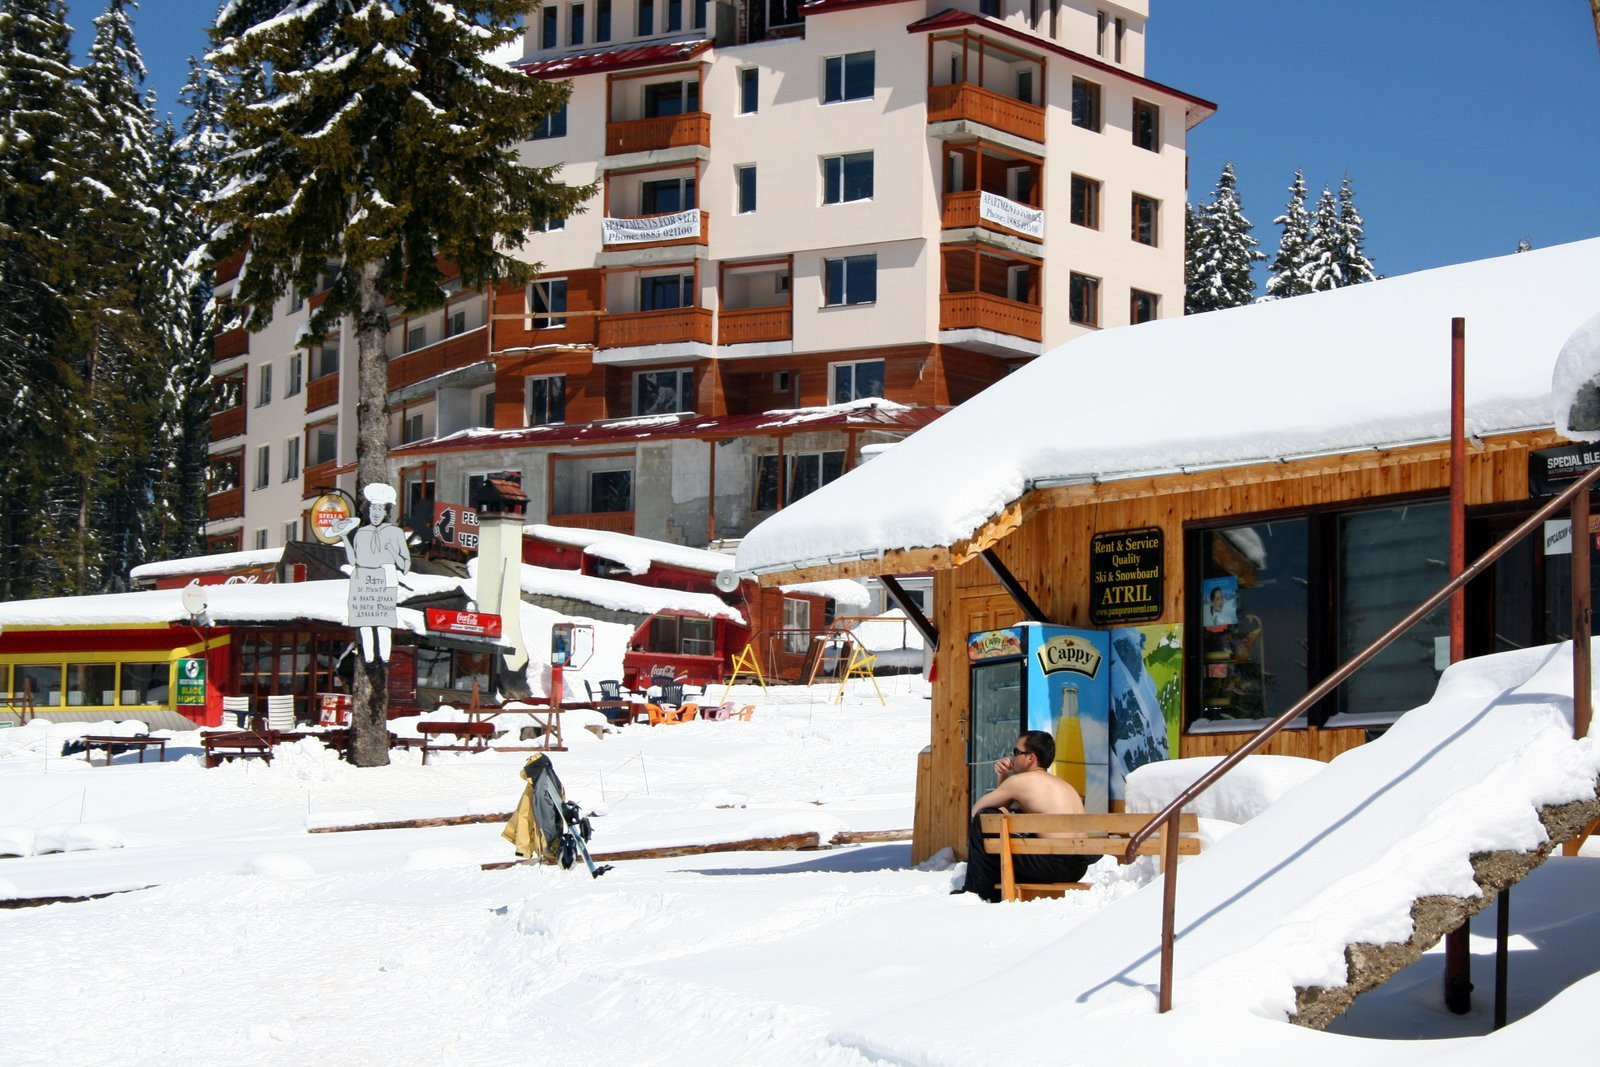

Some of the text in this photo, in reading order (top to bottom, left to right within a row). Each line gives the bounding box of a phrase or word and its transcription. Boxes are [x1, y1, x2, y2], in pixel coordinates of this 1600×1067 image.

[605, 218, 658, 230] APARTMENTS
[659, 215, 676, 227] FOR
[608, 232, 639, 241] Phone:
[640, 230, 661, 240] 0885
[1547, 454, 1582, 469] SPECIAL
[1095, 536, 1159, 553] Rent & Service
[1112, 553, 1140, 567] Quality
[1095, 566, 1159, 583] Ski & Snowboard
[1101, 584, 1152, 604] ATRIL
[456, 612, 478, 625] Coca-Cola
[1047, 646, 1094, 665] Cappy
